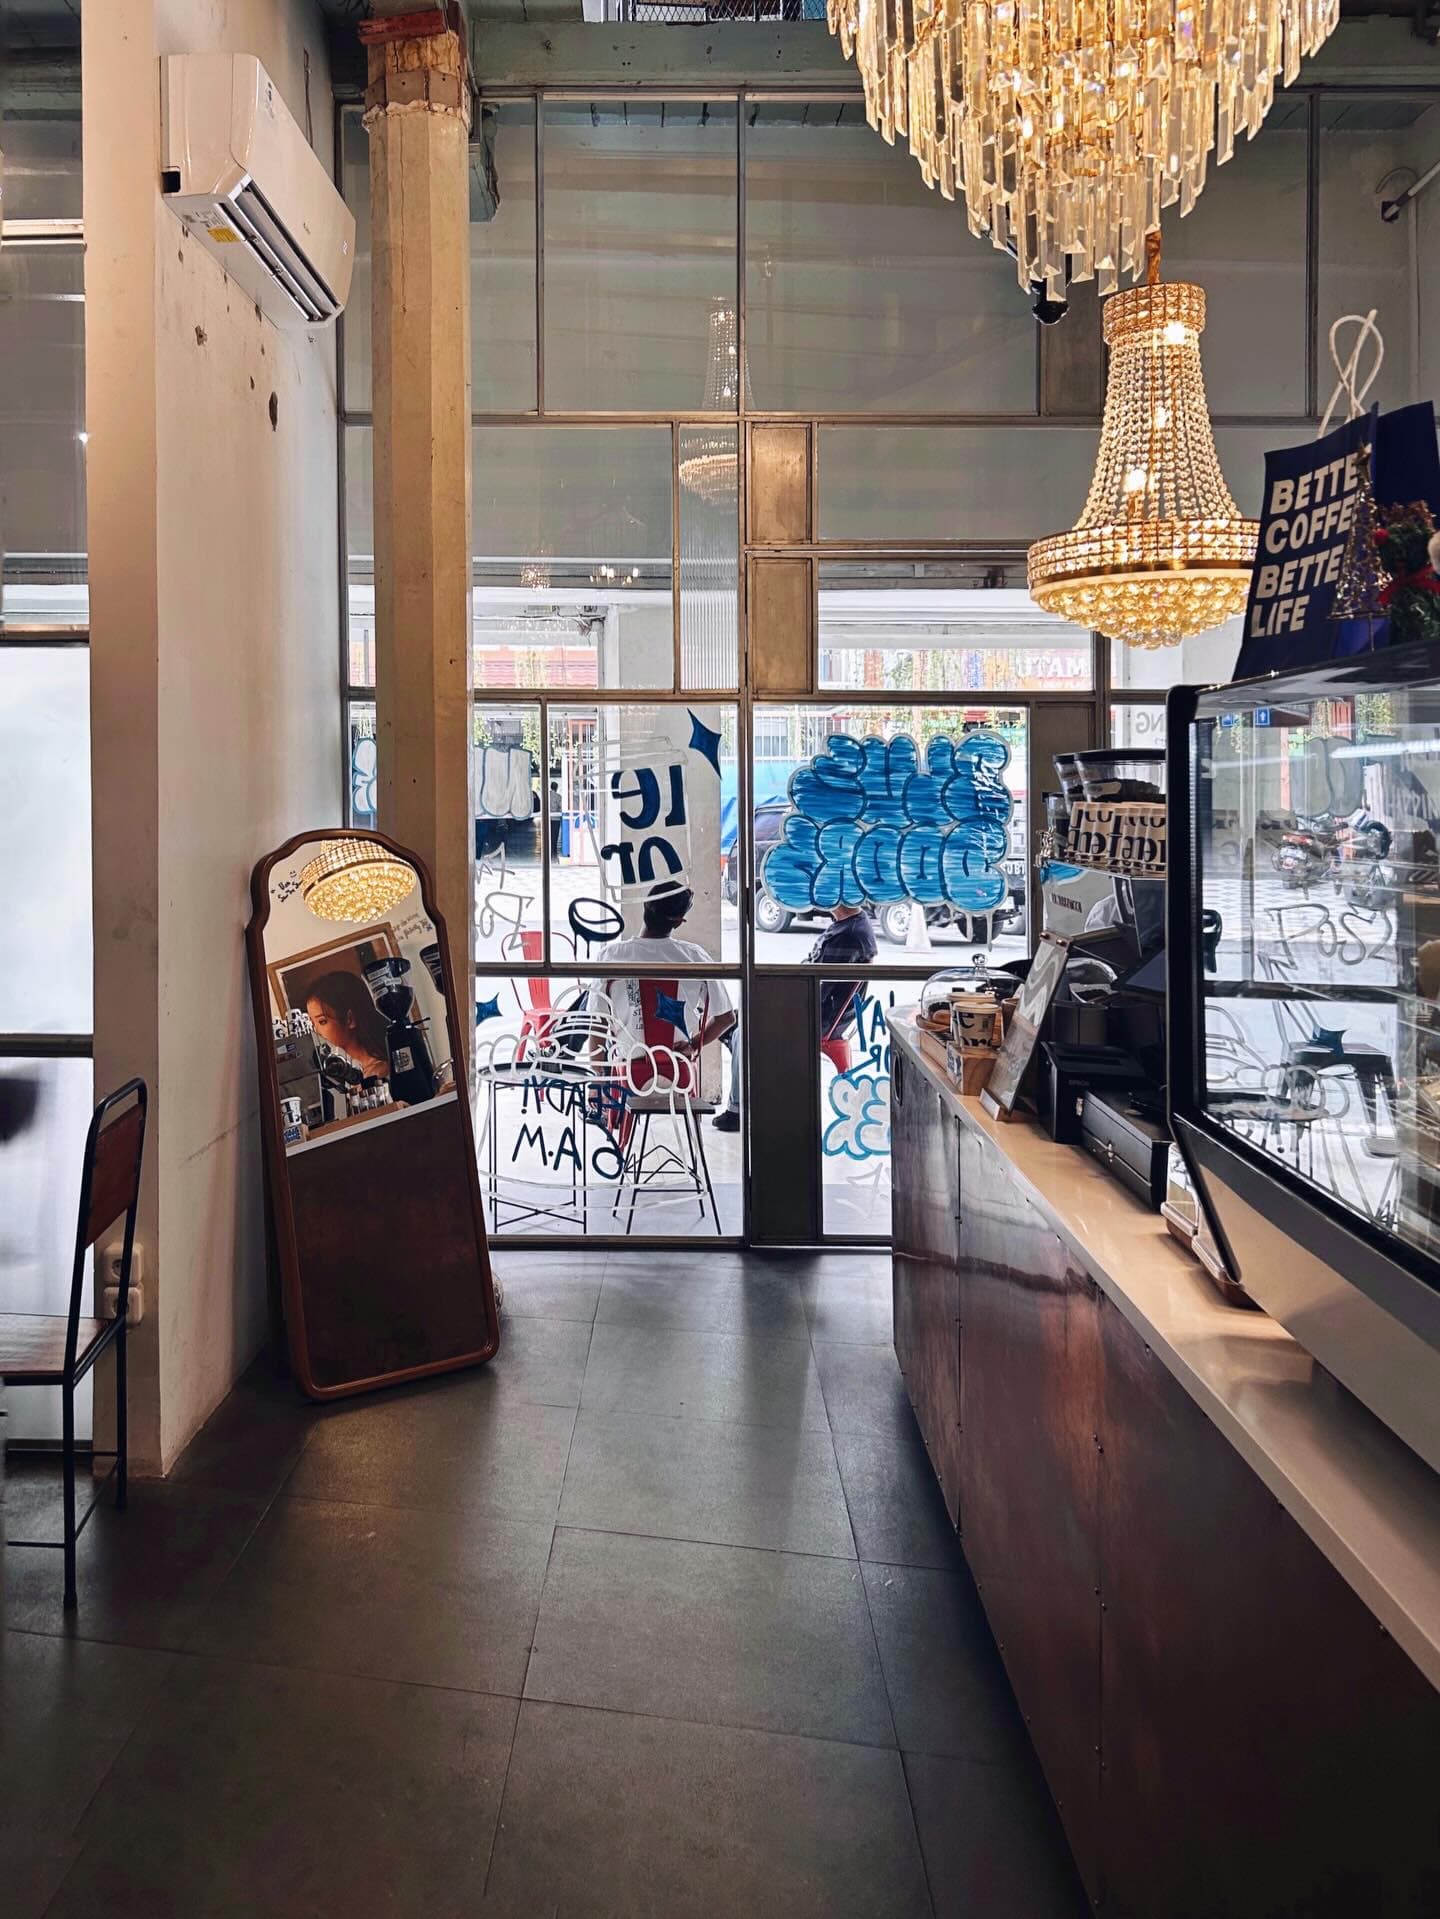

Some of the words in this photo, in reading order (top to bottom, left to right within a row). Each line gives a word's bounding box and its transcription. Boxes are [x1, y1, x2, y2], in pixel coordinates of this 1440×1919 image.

[1270, 452, 1359, 505] BETTE
[1265, 494, 1356, 554] COFFE
[1256, 543, 1344, 599] BETTE
[1251, 595, 1310, 637] LIFE
[1015, 655, 1090, 678] UTAM
